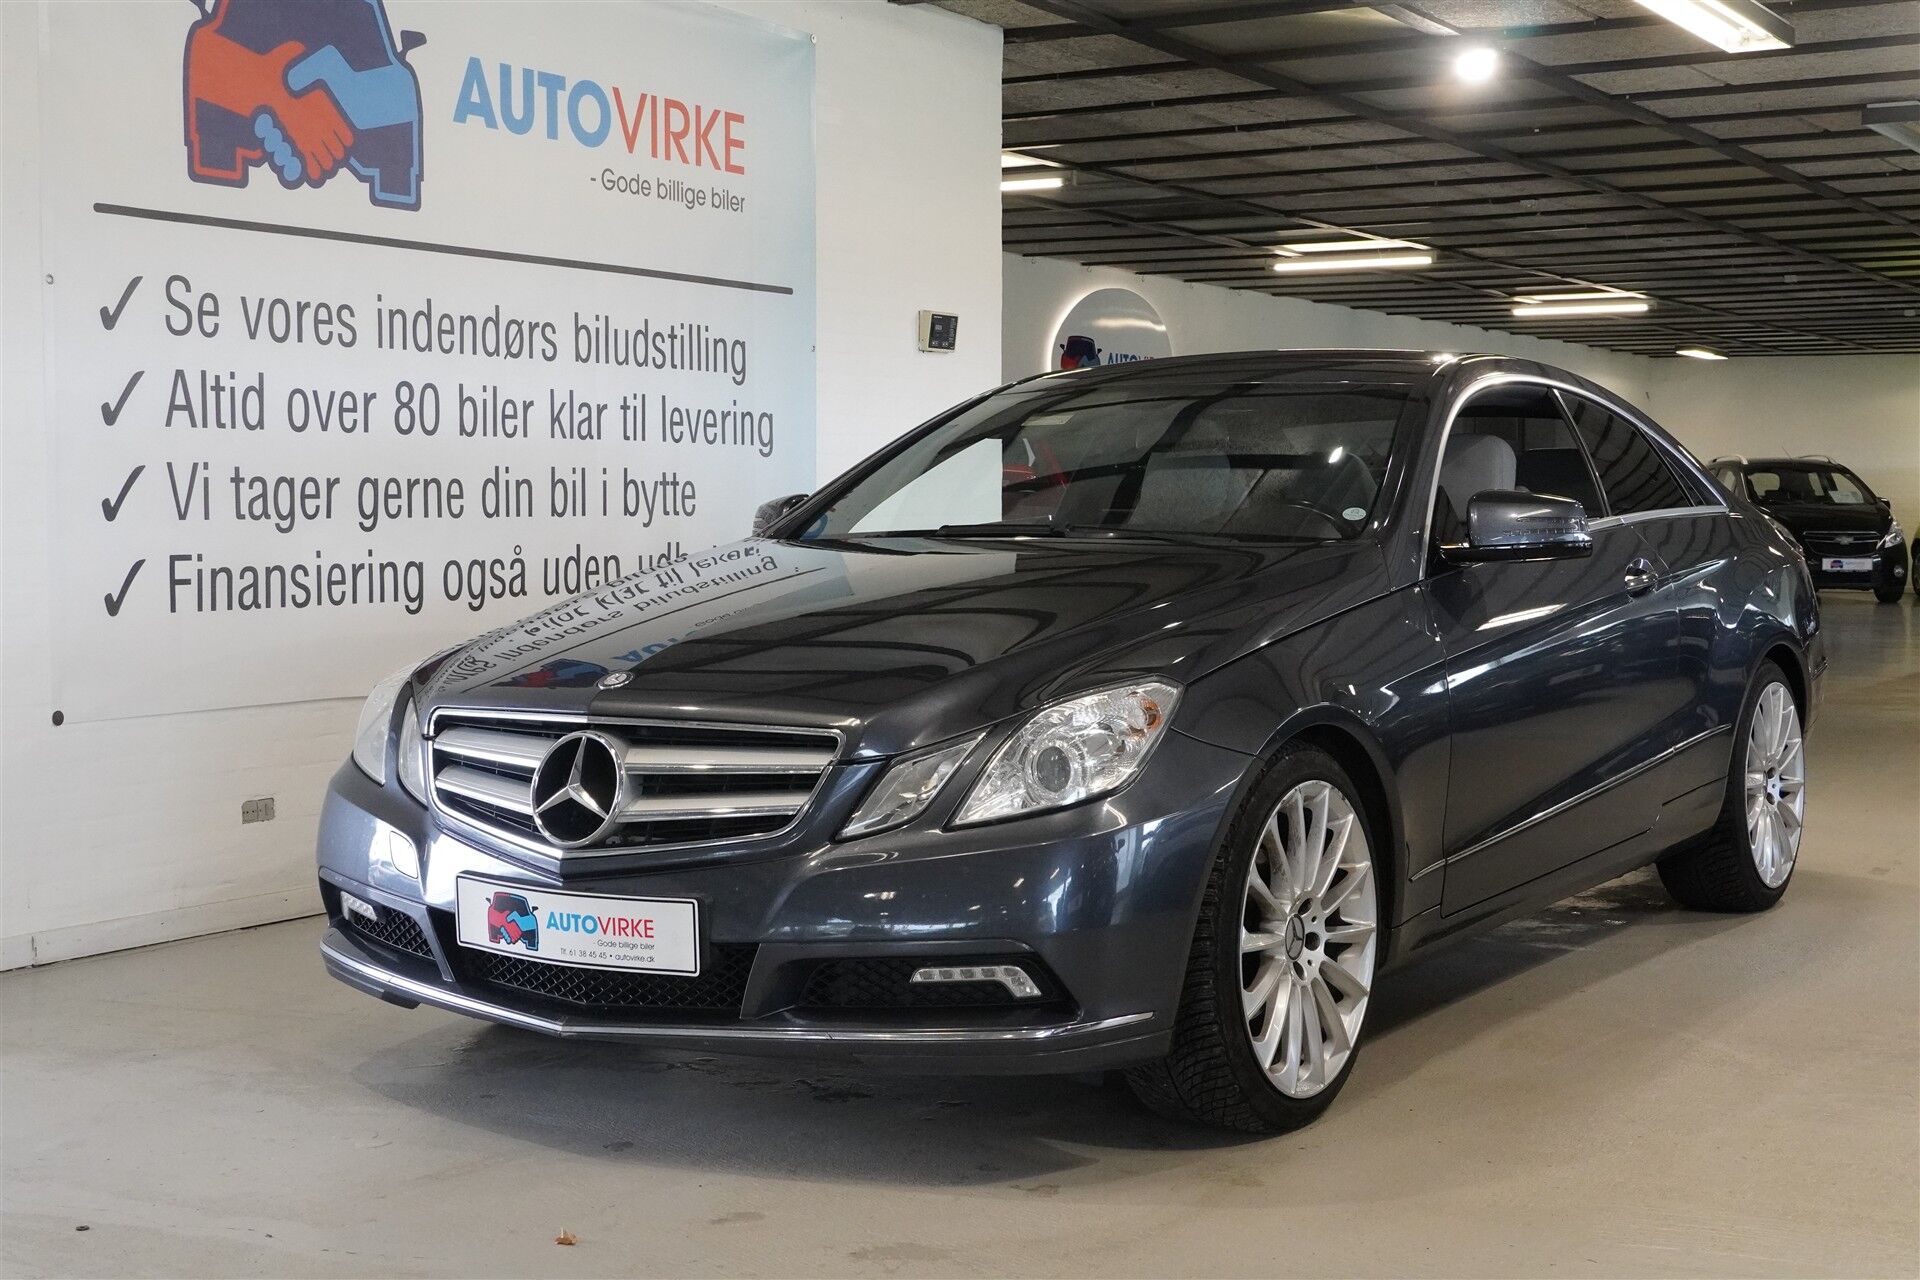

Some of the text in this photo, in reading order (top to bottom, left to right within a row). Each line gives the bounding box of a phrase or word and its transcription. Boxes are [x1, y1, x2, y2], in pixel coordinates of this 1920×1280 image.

[453, 56, 746, 175] AUTOVIRKE
[601, 168, 651, 197] Gode
[656, 177, 706, 210] billige
[711, 187, 745, 213] biler
[165, 274, 747, 385] Se vores indendørs biludstilling
[165, 369, 774, 458] Altid over 80 biler klar til levering
[166, 461, 696, 534] Vi tager gerne din bil i bytte
[168, 550, 426, 615] Finansiering
[442, 545, 527, 613] også
[543, 543, 620, 597] uden
[546, 911, 655, 939] AUTOVIRKE
[569, 948, 577, 957] 61
[579, 949, 587, 958] 38
[588, 950, 597, 959] 45
[598, 951, 608, 960] 45
[614, 953, 655, 963] autovirke.dk
[597, 939, 655, 951] Gode billige biler
